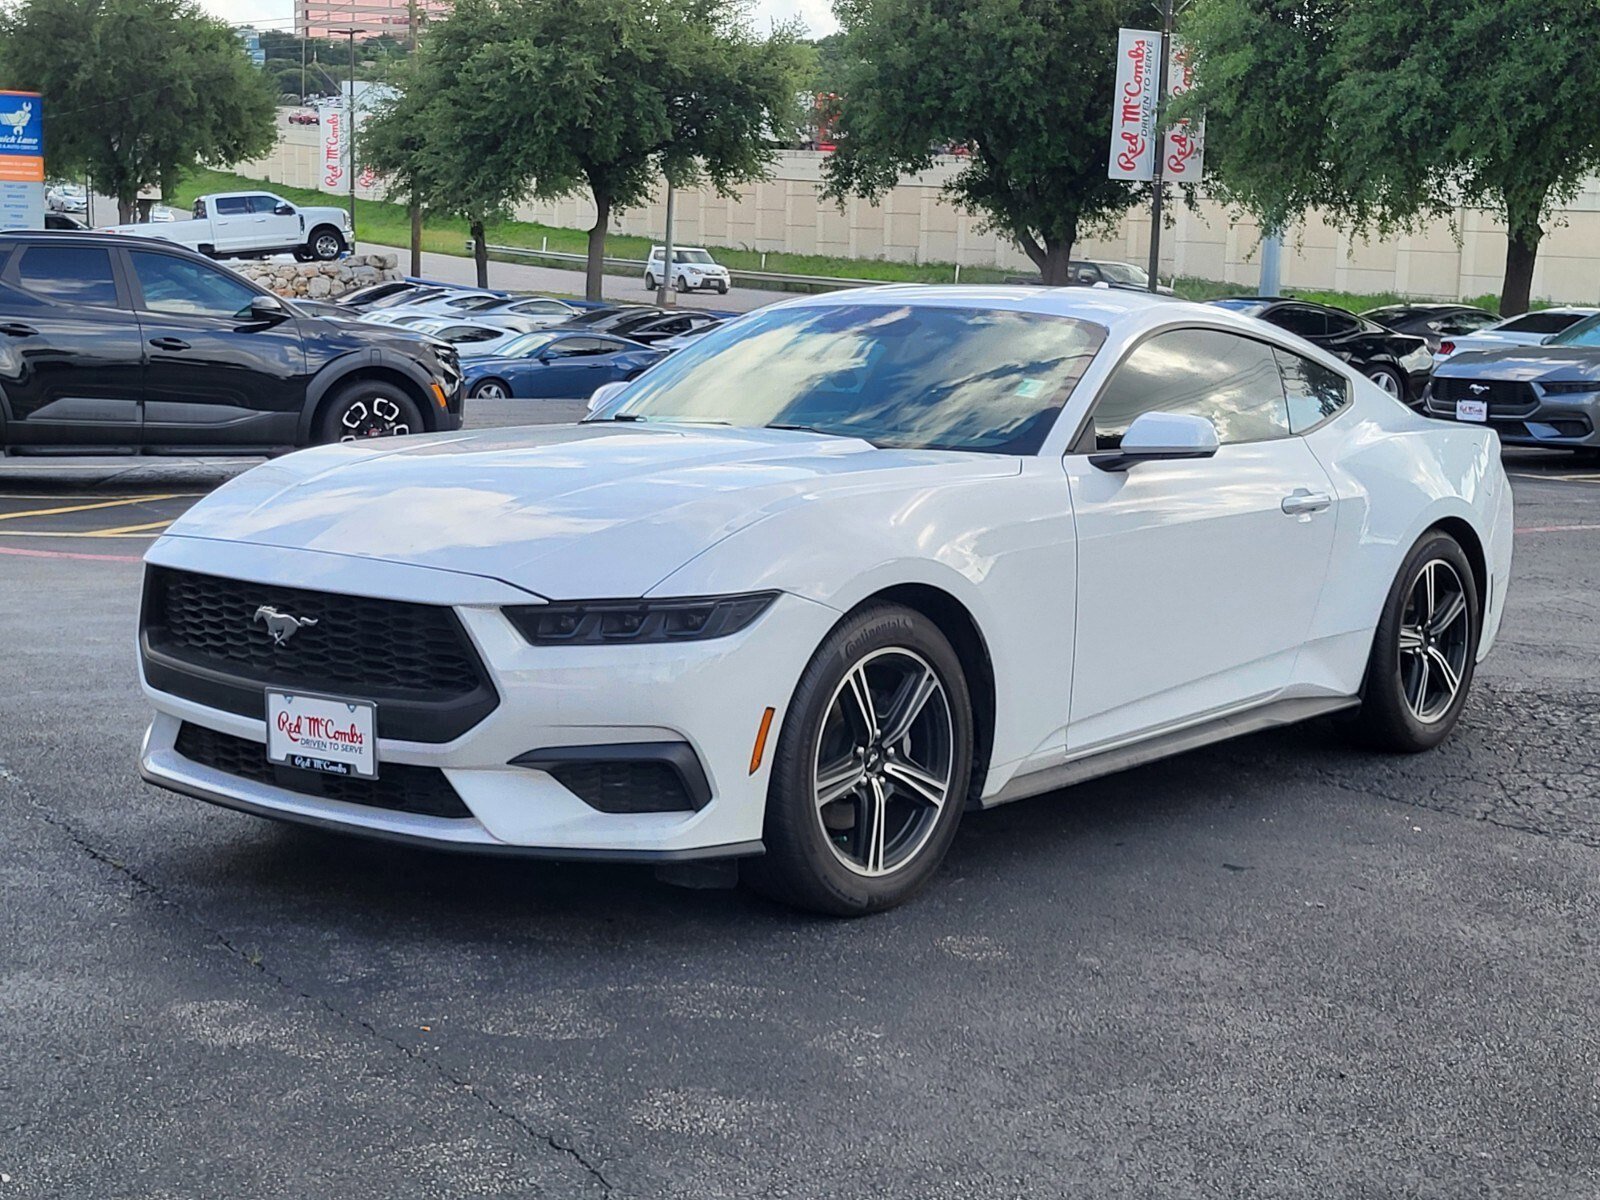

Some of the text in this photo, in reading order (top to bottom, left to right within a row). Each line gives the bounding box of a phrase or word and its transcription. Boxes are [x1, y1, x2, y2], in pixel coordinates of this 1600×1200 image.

[1117, 39, 1146, 172] Red McCombs
[1141, 40, 1154, 138] DRIVEN TO SERVE
[17, 135, 38, 145] Lane
[324, 113, 343, 187] Red McCombs
[1167, 134, 1194, 173] Red
[277, 710, 363, 745] Red McCombs
[300, 737, 364, 755] DRIVEN TO SERVE
[294, 755, 348, 774] Red McCombs
